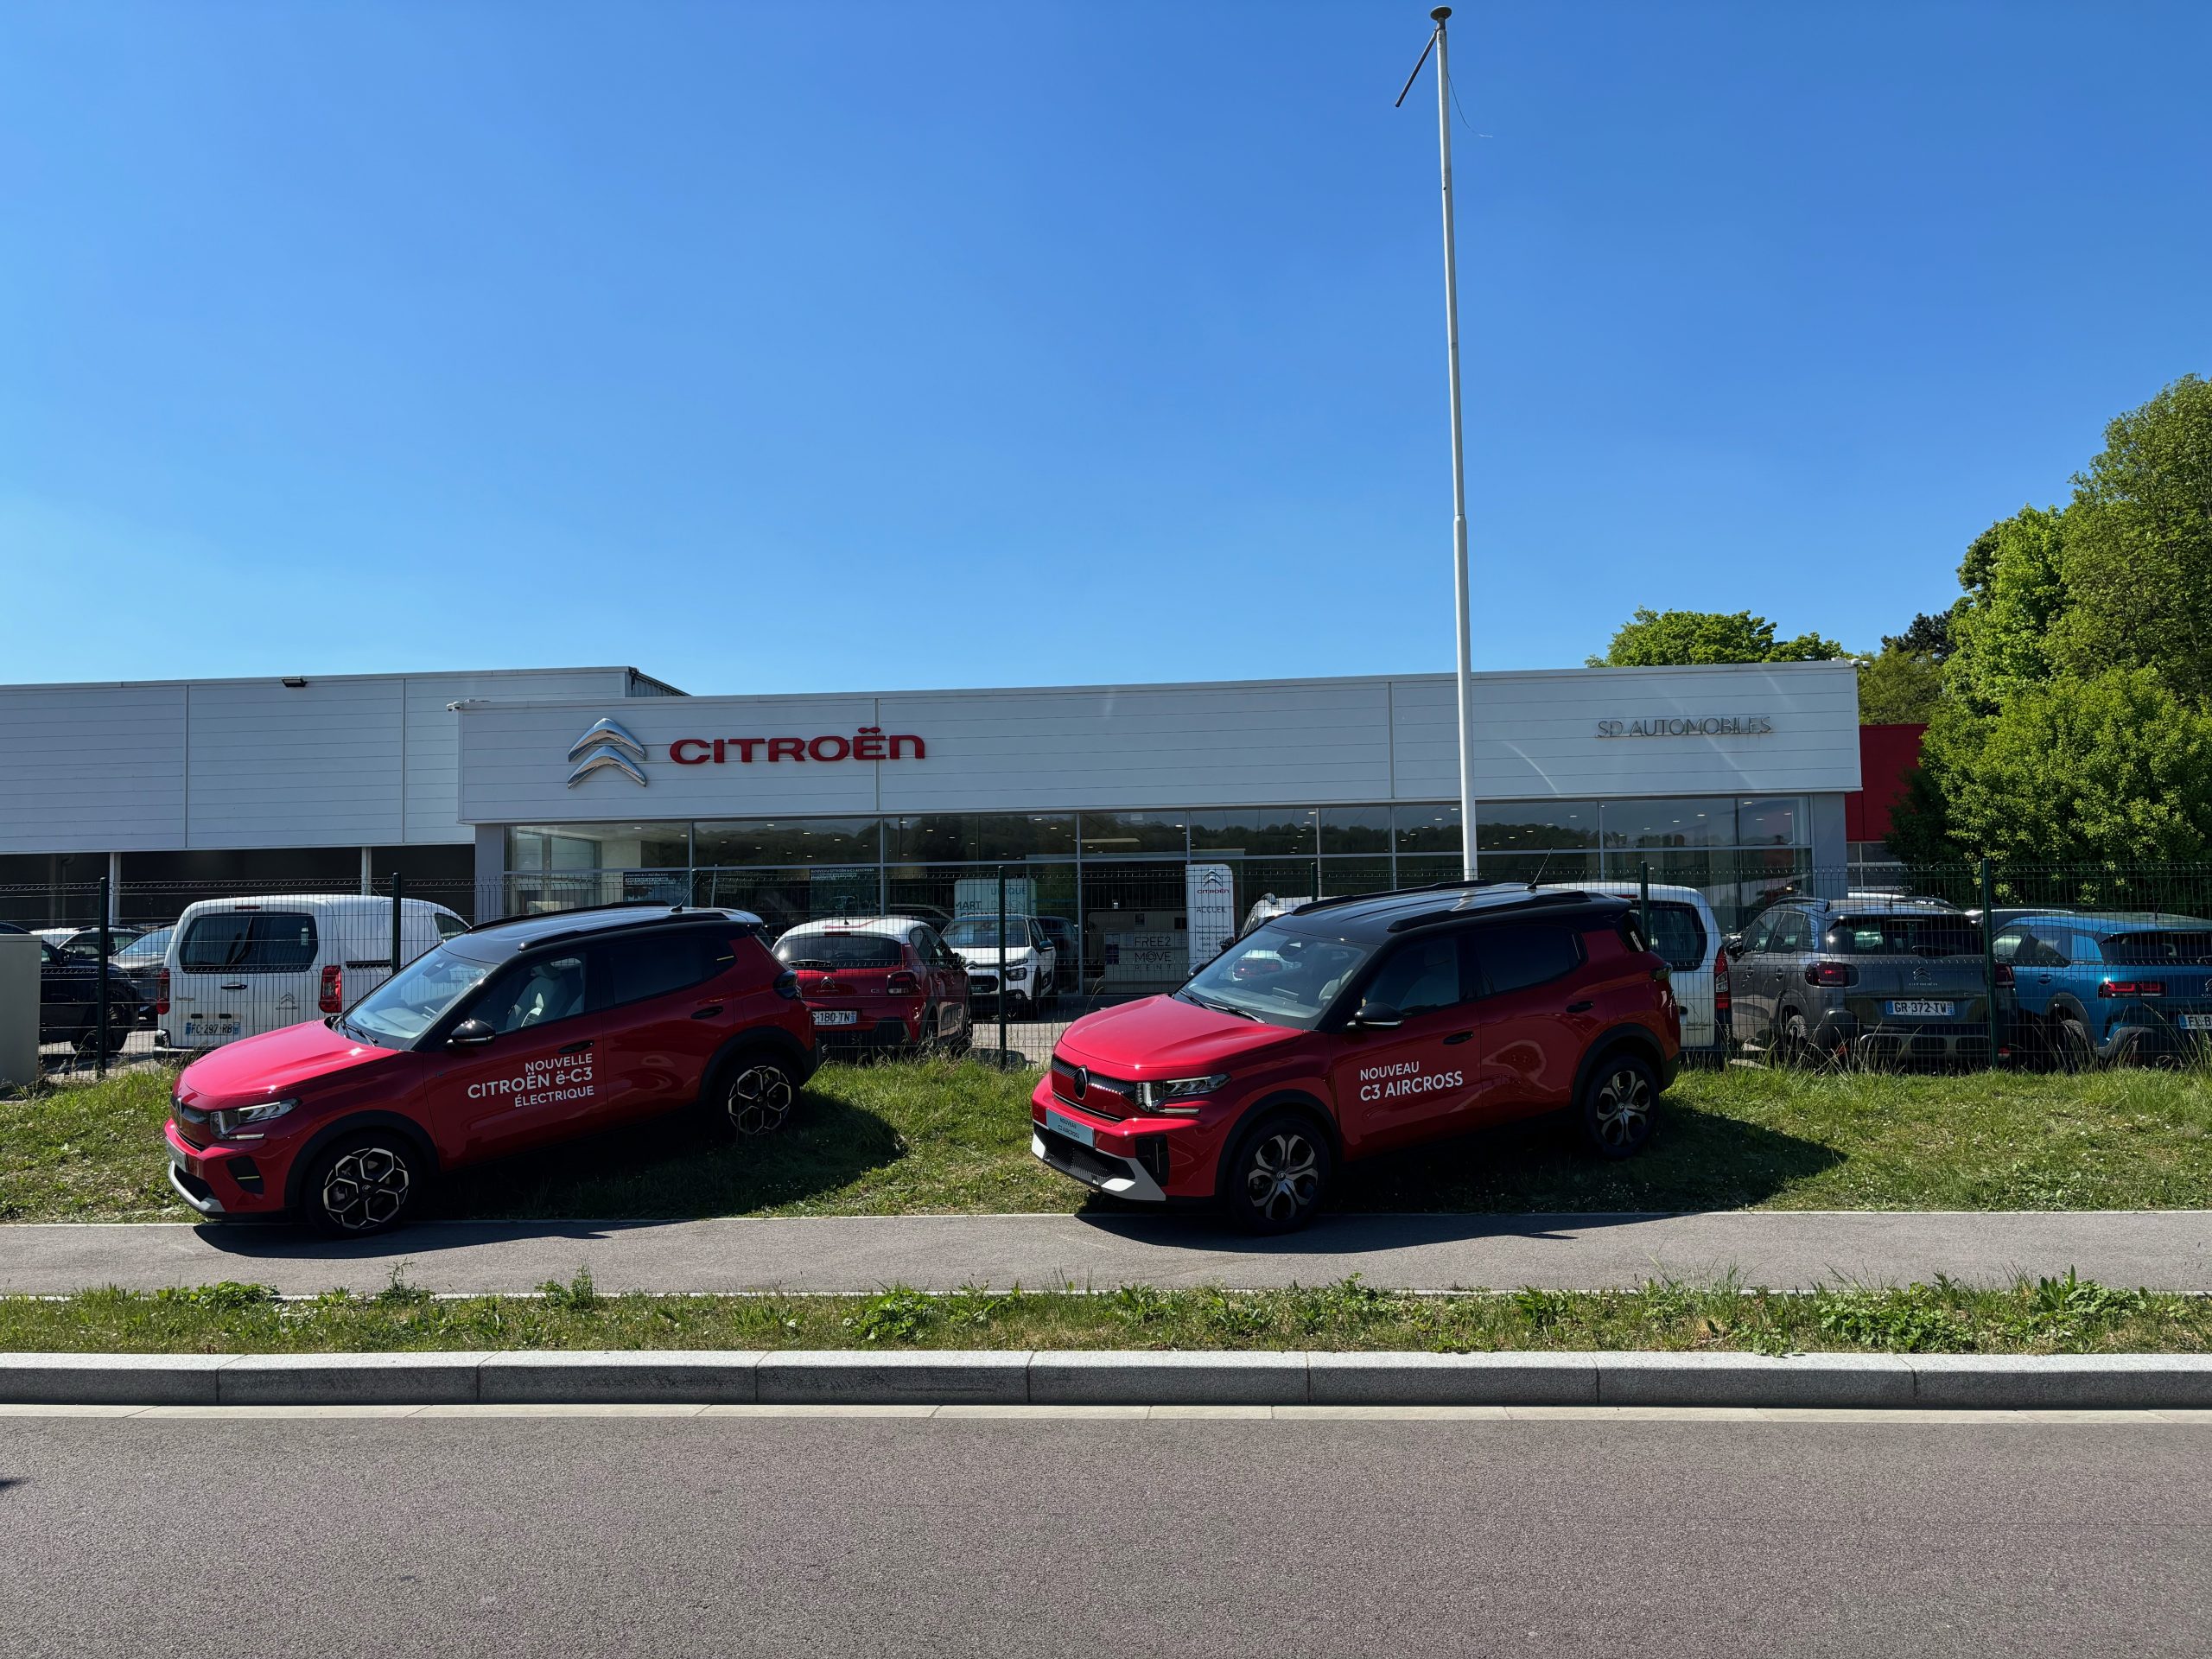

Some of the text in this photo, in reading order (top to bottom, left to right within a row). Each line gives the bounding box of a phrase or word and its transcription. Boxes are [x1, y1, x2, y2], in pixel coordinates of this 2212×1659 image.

[1597, 716, 1771, 737] SD AUTOMOBILES
[669, 727, 925, 765] CITROËN
[990, 887, 1027, 895] UIQUE
[1135, 936, 1171, 947] FREE2
[1135, 951, 1172, 963] MOVE
[524, 1052, 593, 1073] NOUVELLE
[1360, 1060, 1420, 1081] NOUVEAU
[467, 1066, 593, 1099] CITROËN ë-C3
[1360, 1071, 1463, 1102] C3 AIRCROSS
[514, 1085, 594, 1108] ÉLECTRIQUE
